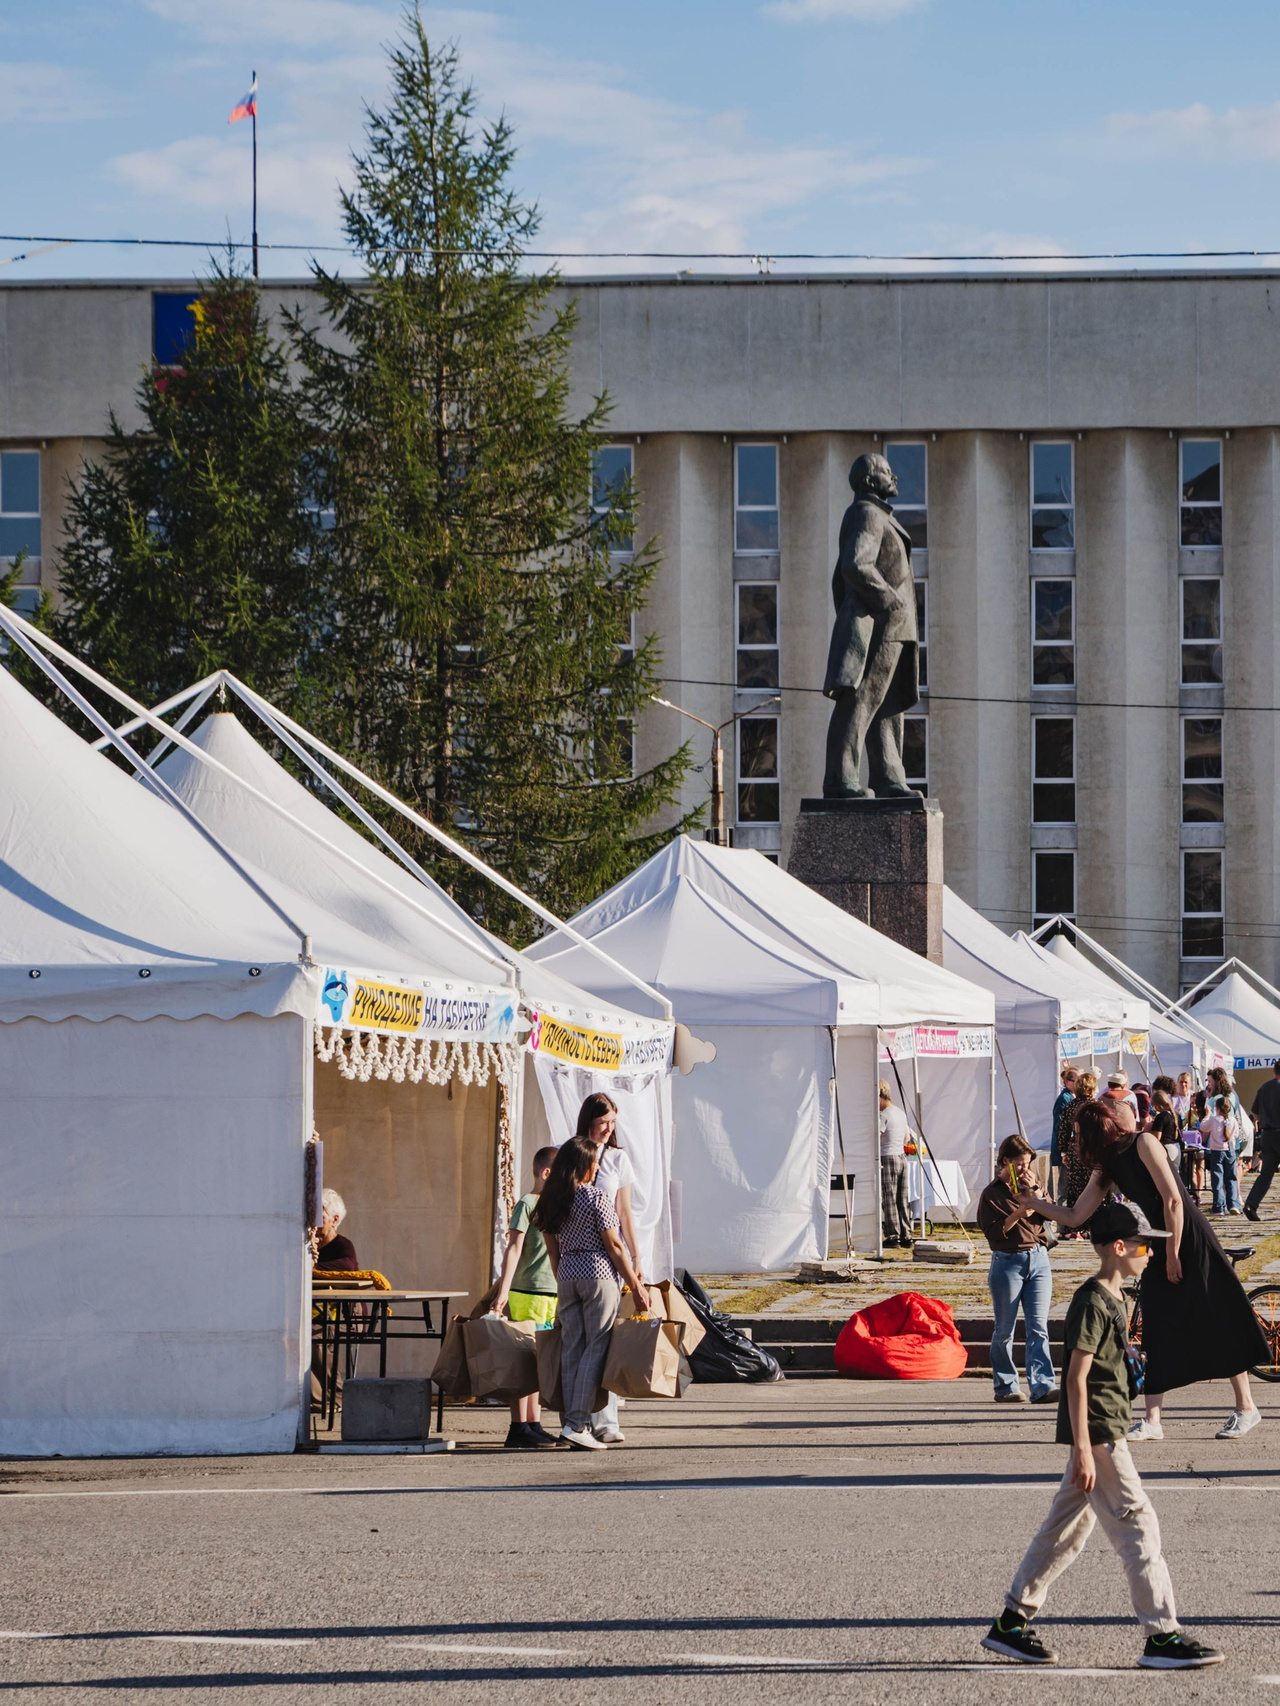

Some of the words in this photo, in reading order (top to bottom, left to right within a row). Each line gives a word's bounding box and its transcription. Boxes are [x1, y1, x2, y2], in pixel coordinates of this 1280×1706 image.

[352, 985, 422, 1029] РУКОДЕЛИЕ
[422, 996, 438, 1028] НА
[439, 998, 490, 1031] ТАБУРЕТКЕ
[592, 1035, 621, 1065] СЕВЕРА
[1248, 1058, 1262, 1067] НА
